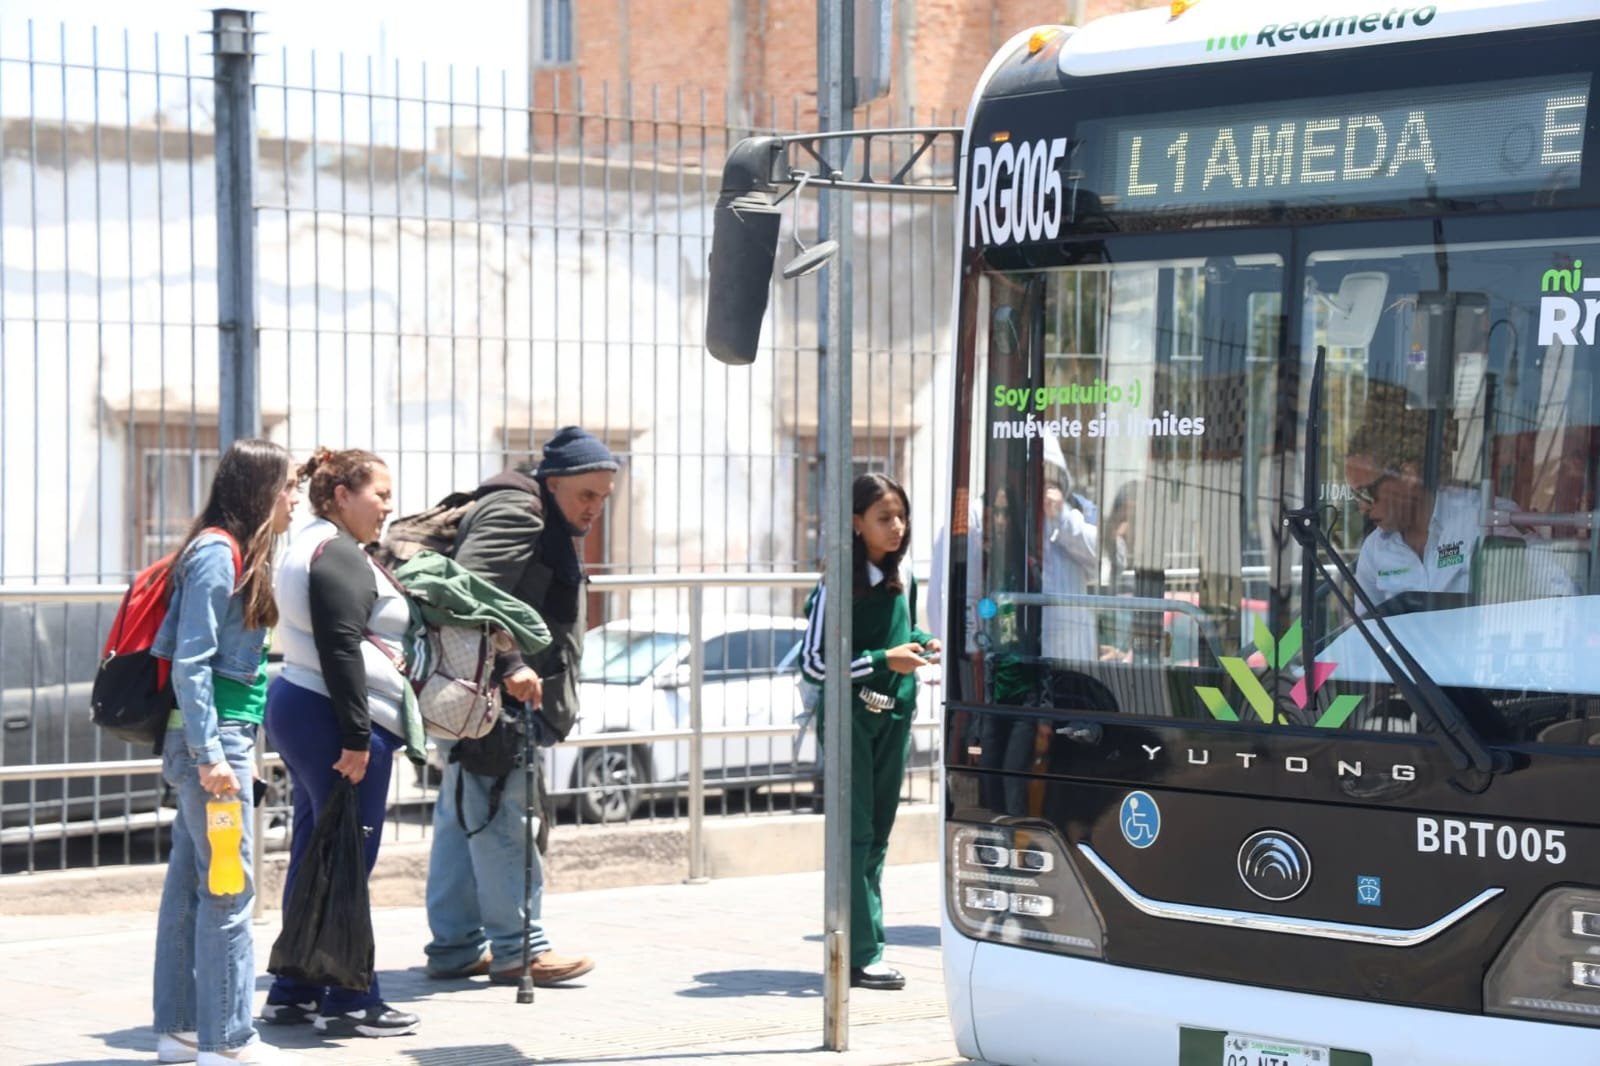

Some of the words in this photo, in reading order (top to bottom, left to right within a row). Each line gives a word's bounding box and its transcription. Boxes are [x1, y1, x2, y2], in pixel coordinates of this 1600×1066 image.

[1256, 5, 1434, 48] Redmetro
[969, 137, 1068, 248] RG005
[1541, 259, 1583, 293] mi
[994, 385, 1031, 411] Soy
[1035, 378, 1122, 411] gratuito
[1087, 412, 1121, 438] sin
[1141, 744, 1416, 781] YUTONG
[1416, 817, 1567, 864] BRT005
